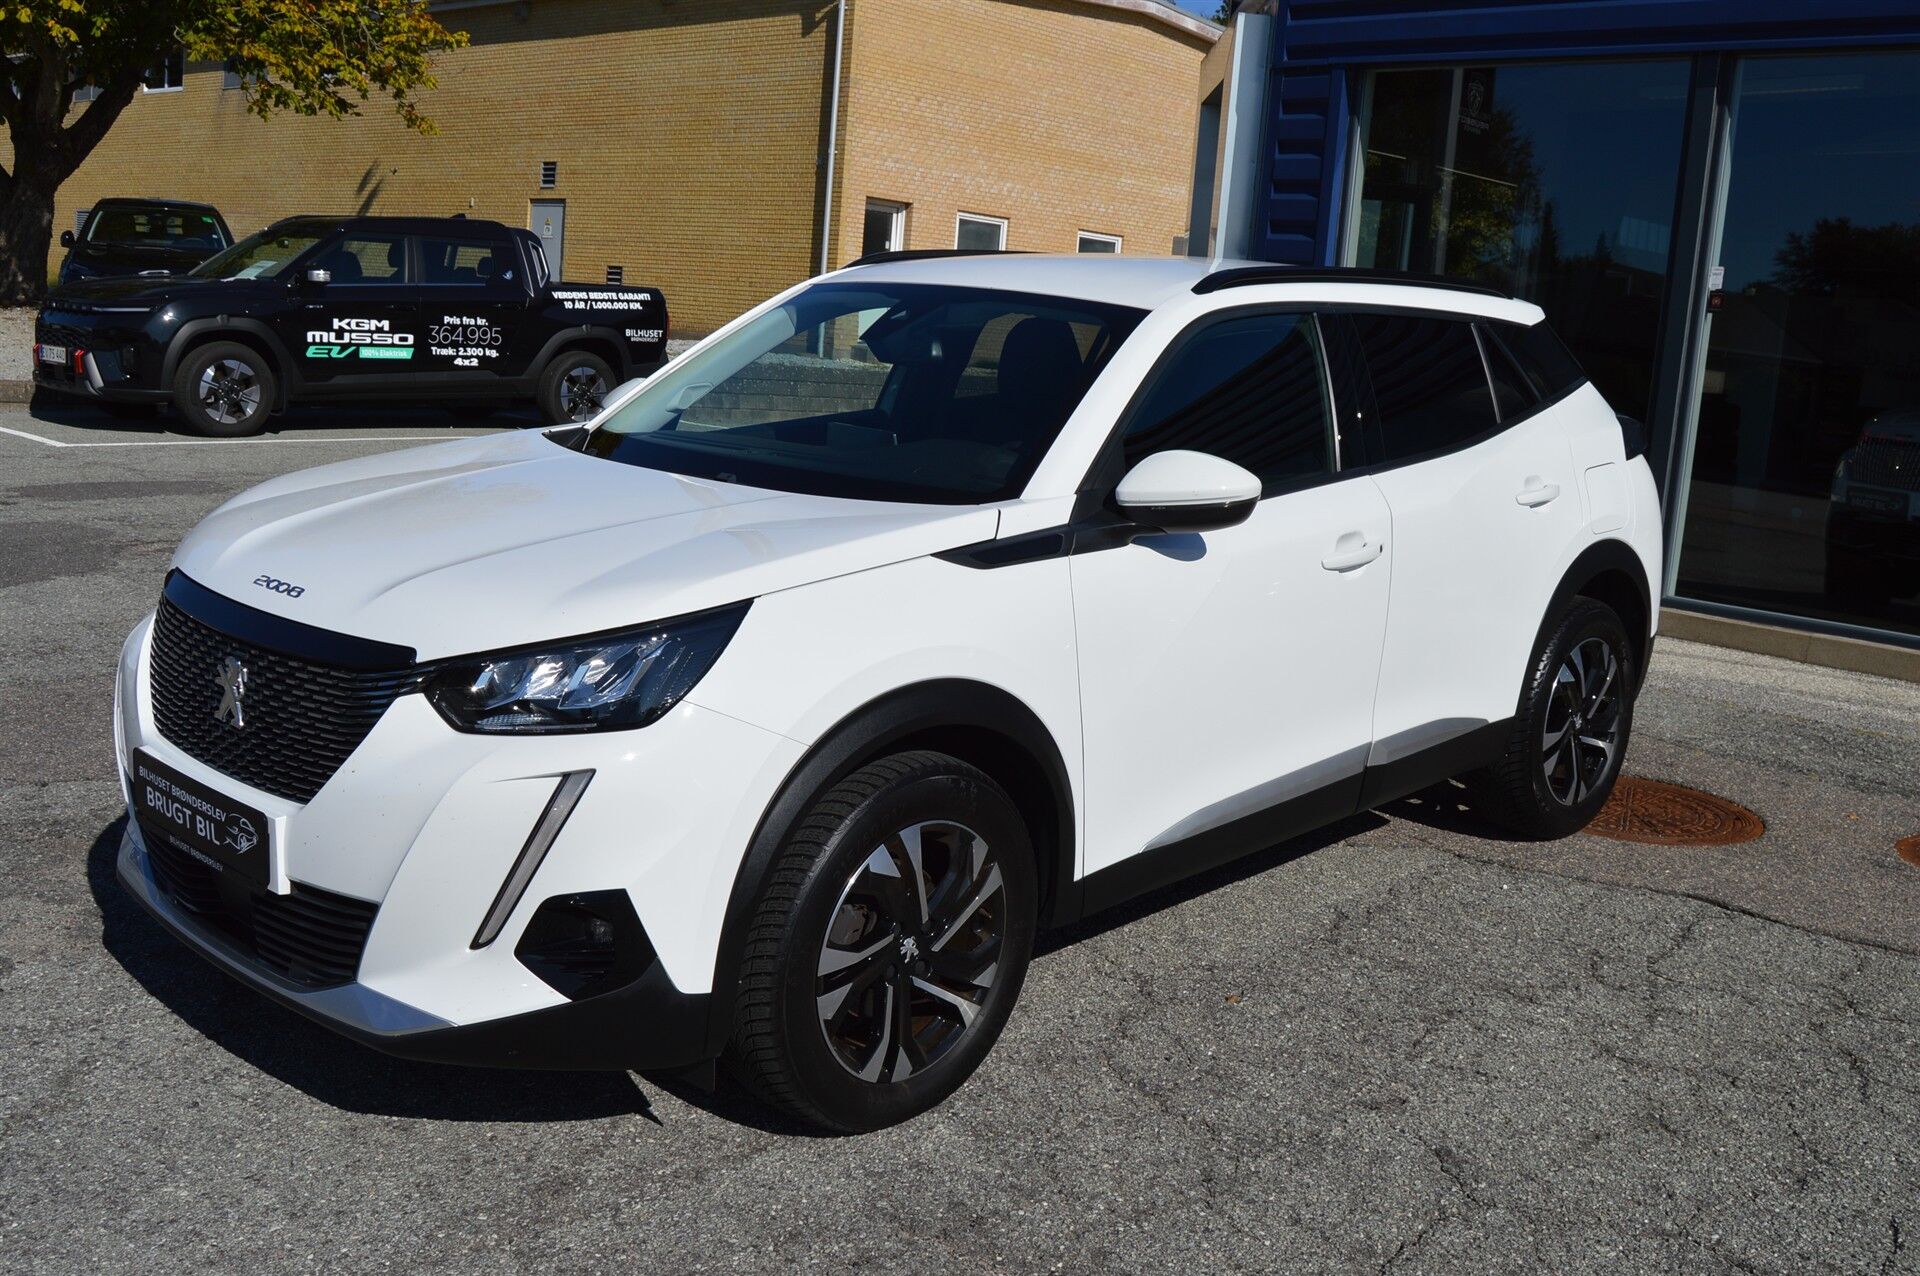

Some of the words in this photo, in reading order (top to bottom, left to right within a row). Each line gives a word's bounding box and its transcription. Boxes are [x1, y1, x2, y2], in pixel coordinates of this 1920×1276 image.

[552, 291, 588, 299] VERDENS
[589, 292, 617, 300] BEDSTE
[619, 292, 651, 301] GARANTI
[564, 301, 572, 309] 10
[575, 301, 586, 309] ÅR
[629, 302, 643, 310] KM.
[333, 318, 389, 331] KGM
[444, 316, 461, 325] Pris
[462, 316, 475, 325] fra
[476, 316, 488, 325] kr.
[307, 331, 414, 345] MUSSO
[428, 326, 502, 345] 364.995
[625, 329, 663, 337] BILHUSET
[305, 346, 357, 358] EV
[361, 349, 379, 357] 100%
[431, 347, 456, 356] Træk:
[458, 347, 484, 356] 2.300
[485, 348, 499, 357] kg.
[453, 358, 478, 366] 4x2
[253, 575, 305, 598] 2008
[138, 765, 170, 792] BILHUSET
[171, 784, 226, 822] BRØNDERSLEV
[146, 786, 192, 829] BRUGT
[196, 817, 221, 846] BIL
[169, 835, 190, 853] BILHUSET
